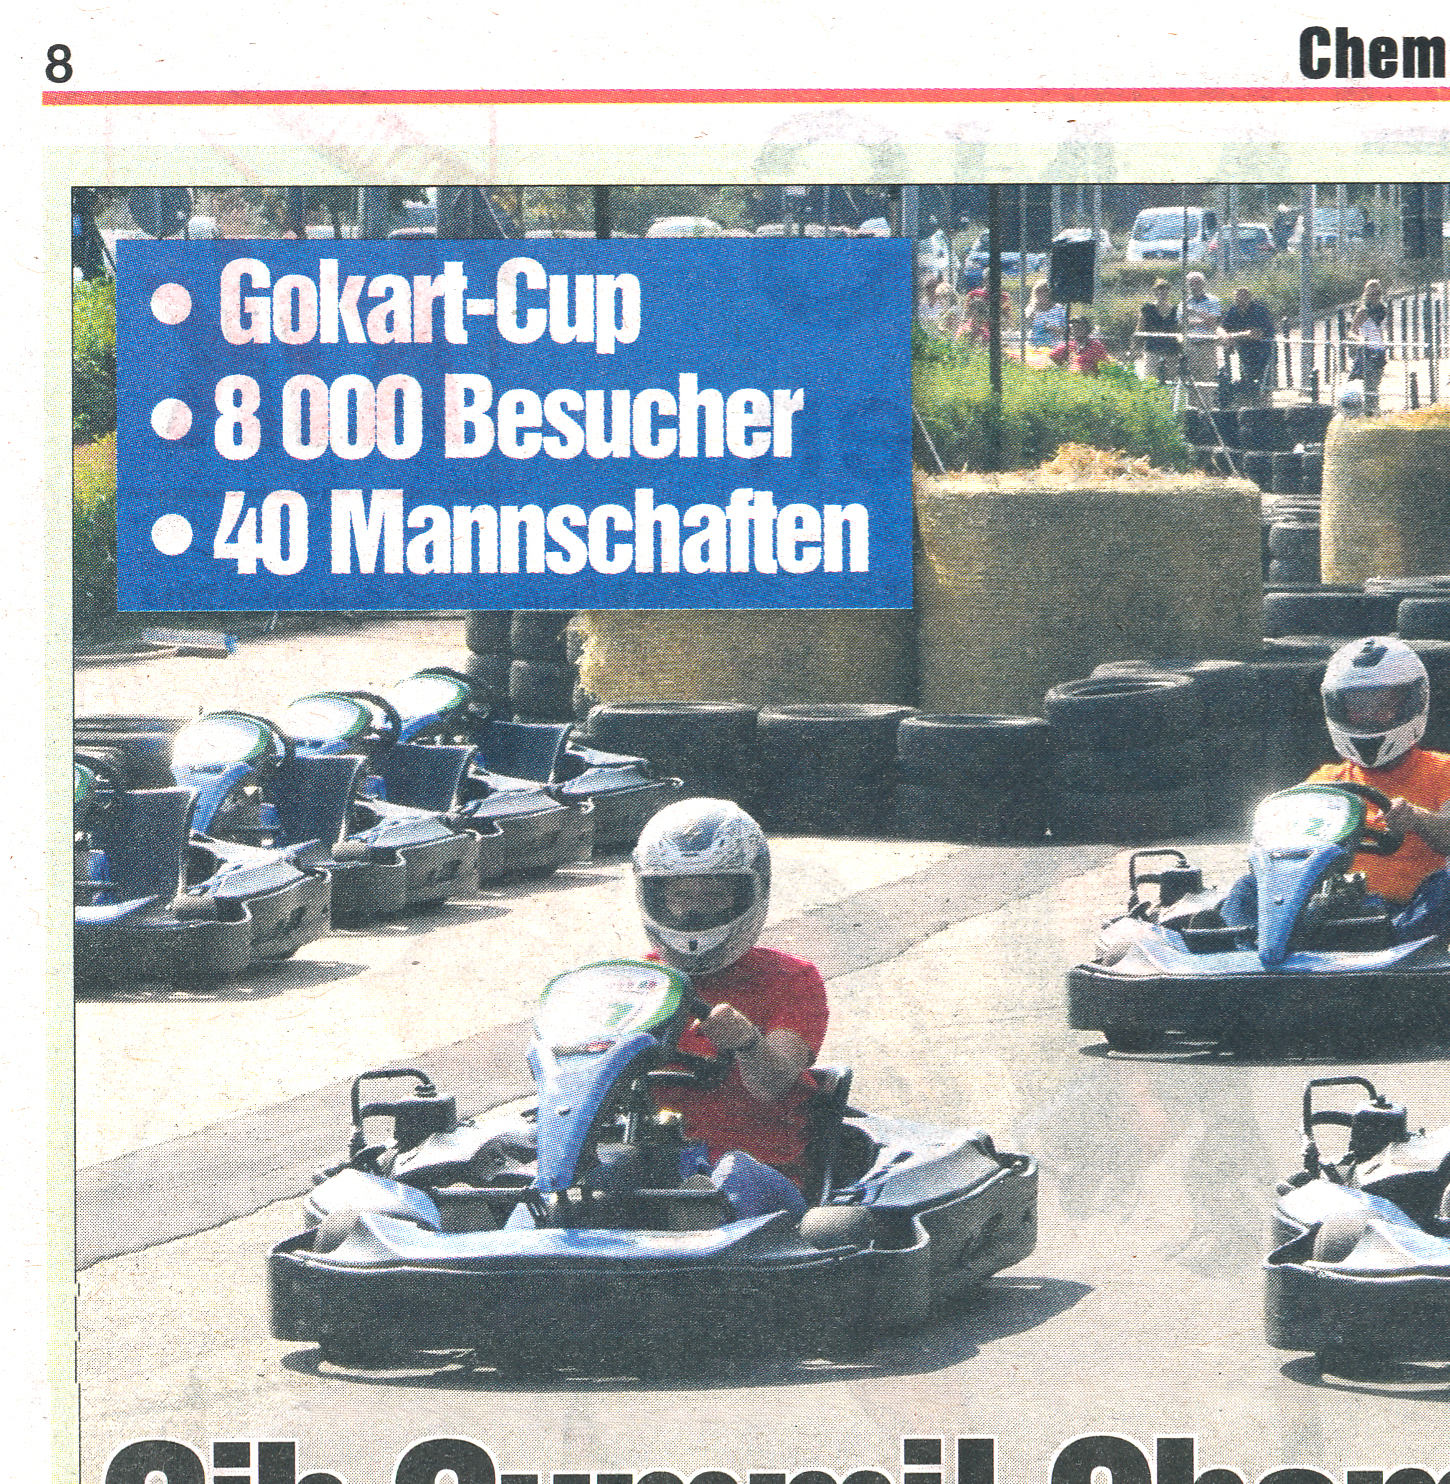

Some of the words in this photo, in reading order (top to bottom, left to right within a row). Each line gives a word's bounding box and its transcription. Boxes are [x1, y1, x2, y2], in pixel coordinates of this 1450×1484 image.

[45, 43, 74, 84] 8
[220, 257, 642, 354] Gokart-Cup
[444, 372, 805, 460] Besucher
[213, 489, 308, 576] 40
[330, 487, 870, 576] Mannschaften
